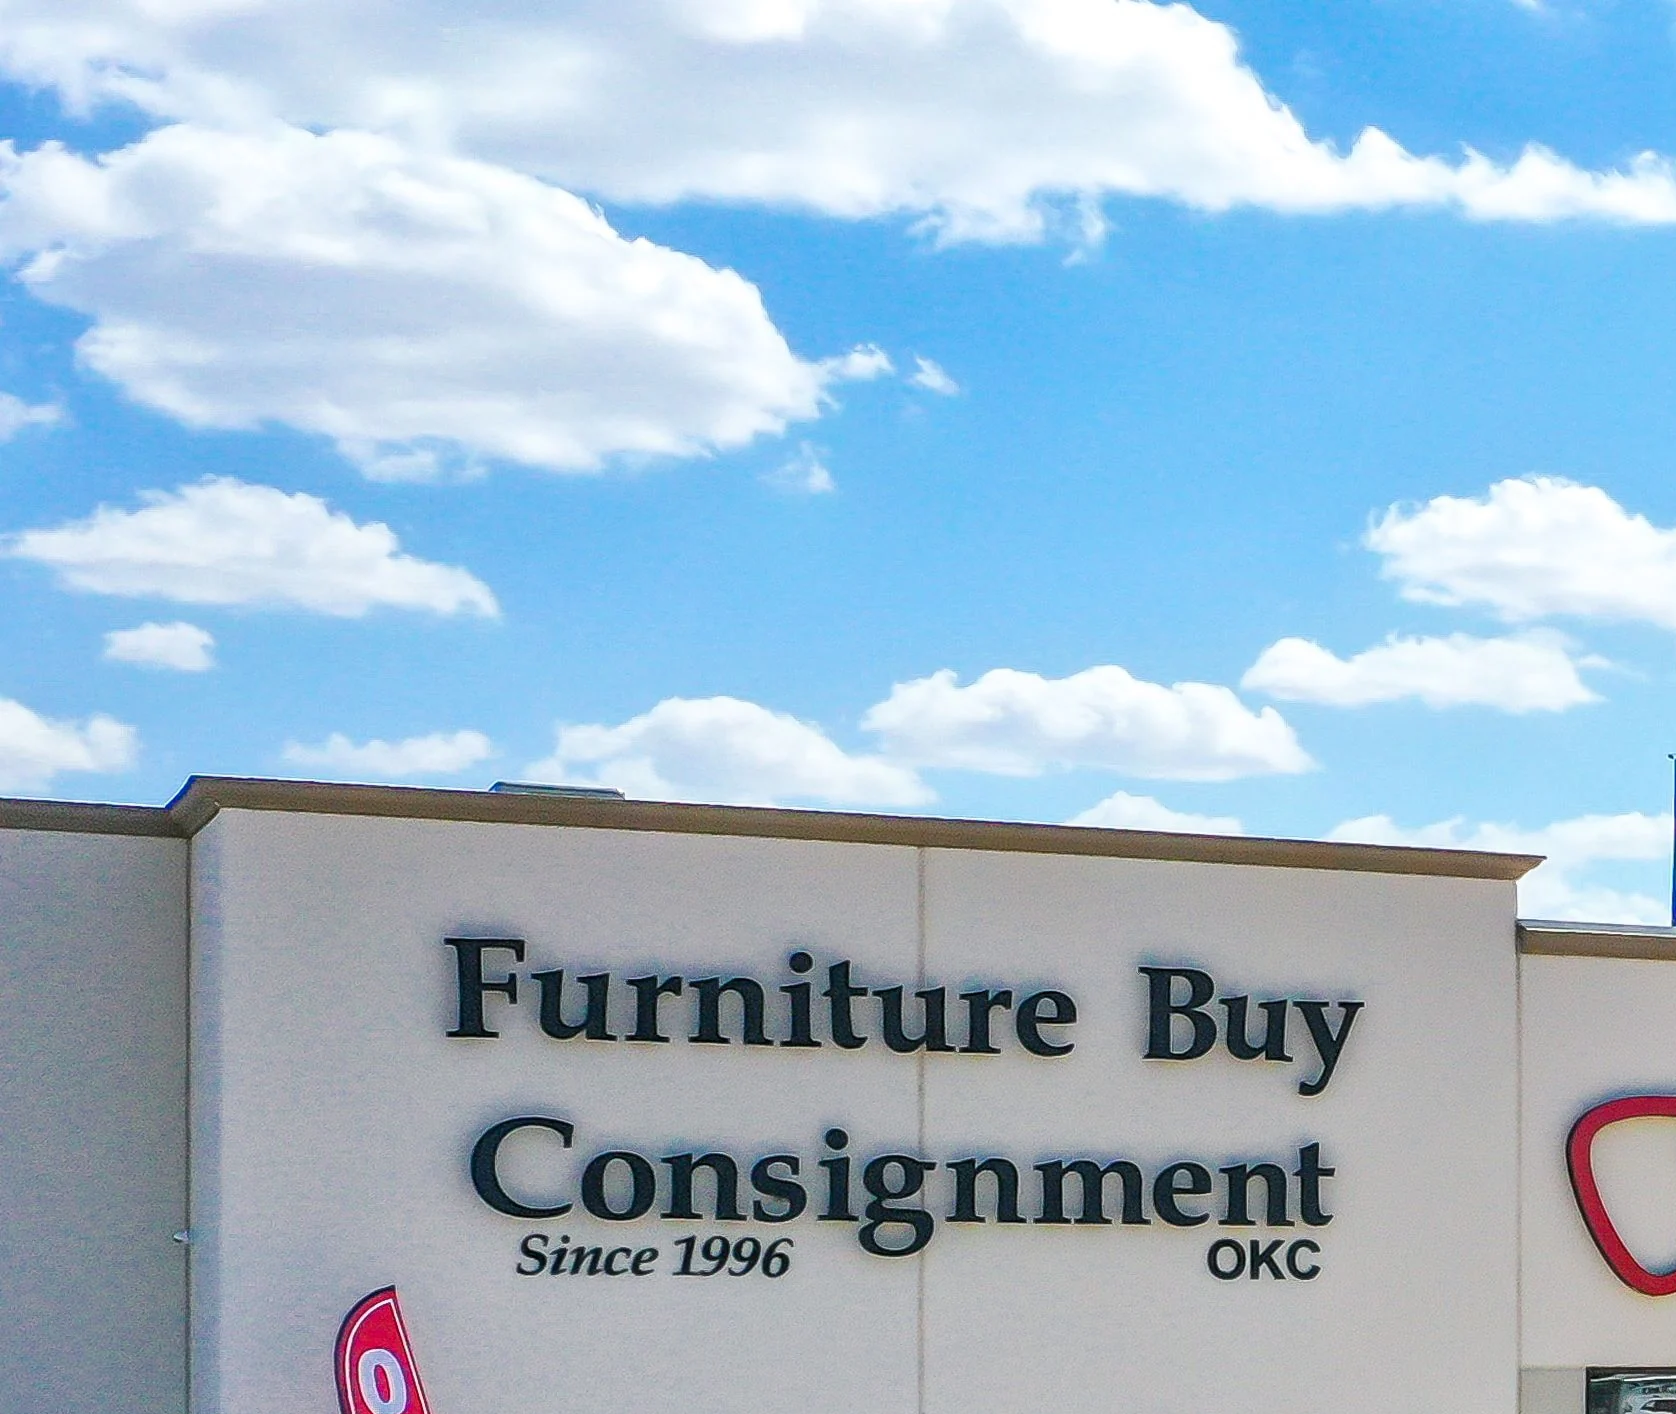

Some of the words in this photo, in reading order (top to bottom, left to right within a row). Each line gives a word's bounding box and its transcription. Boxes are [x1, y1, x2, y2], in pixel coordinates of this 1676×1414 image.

[443, 937, 1077, 1058] Furniture
[1138, 965, 1366, 1097] Buy
[470, 1115, 1337, 1258] Consignment
[516, 1233, 659, 1278] Since
[672, 1234, 795, 1279] 1996
[1207, 1237, 1322, 1282] OKC
